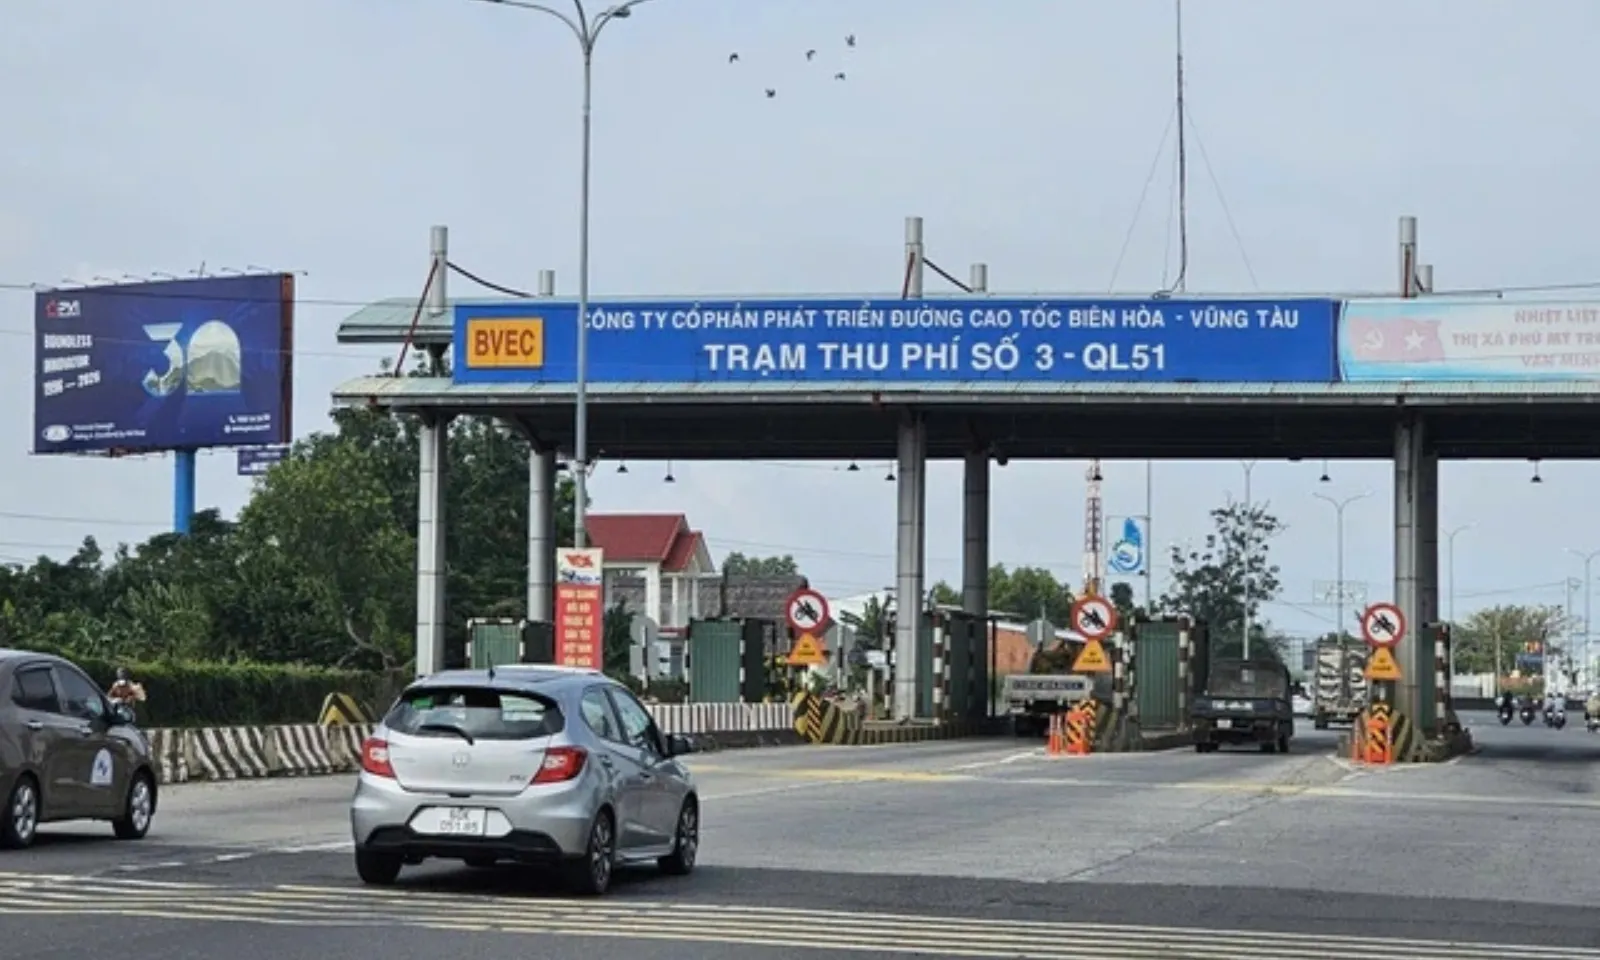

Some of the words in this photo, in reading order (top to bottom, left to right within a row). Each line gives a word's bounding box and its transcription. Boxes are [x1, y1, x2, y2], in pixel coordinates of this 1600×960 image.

[640, 310, 669, 329] TY
[890, 304, 963, 329] ĐƯỜNG
[969, 309, 1012, 328] CAO
[1020, 302, 1061, 328] TỐC
[1069, 305, 1116, 328] BIÊN
[1122, 305, 1165, 328] HÒA
[1190, 305, 1248, 329] VŨNG
[1256, 305, 1299, 328] TÀU
[475, 328, 536, 357] BVEC
[703, 343, 806, 376] TRẠM
[817, 343, 889, 371] THU
[902, 335, 961, 371] PHÍ
[970, 332, 1020, 371] SỐ
[1035, 343, 1054, 371] 3
[1082, 343, 1165, 372] QL51
